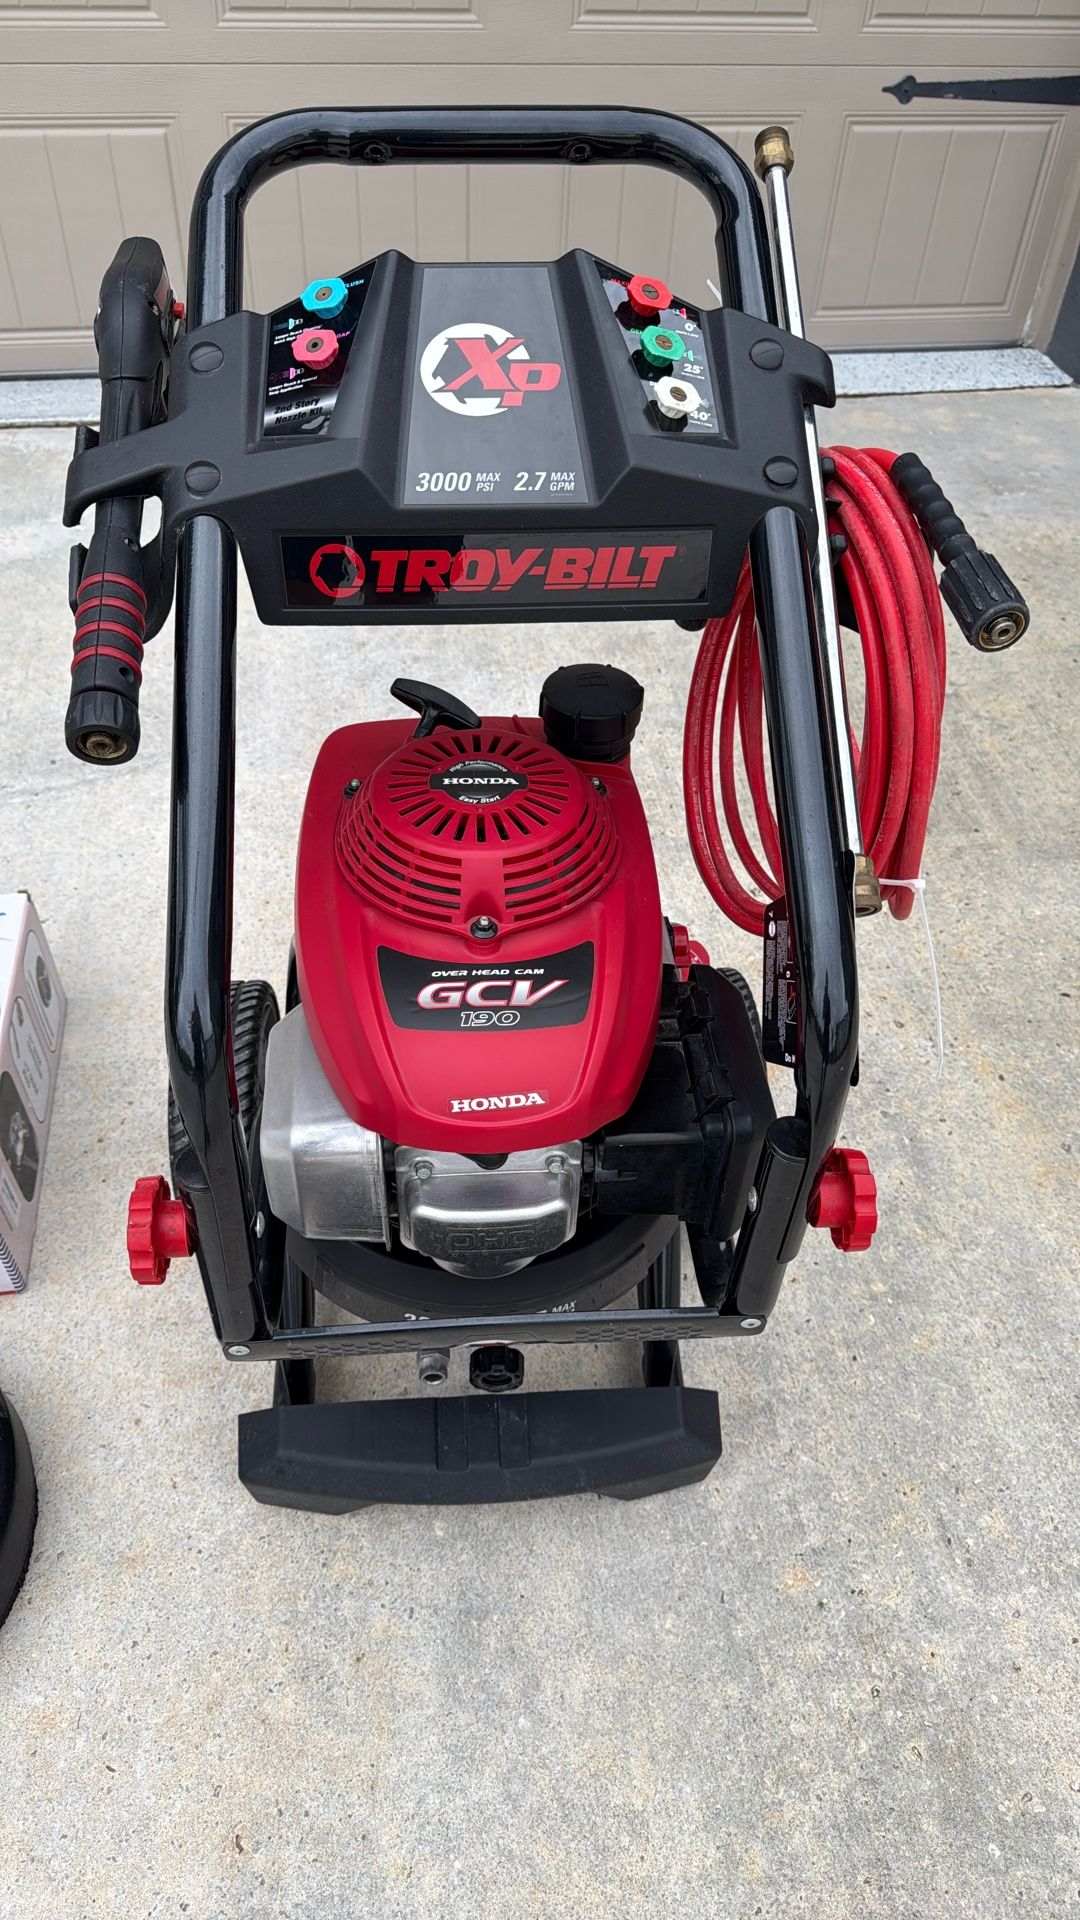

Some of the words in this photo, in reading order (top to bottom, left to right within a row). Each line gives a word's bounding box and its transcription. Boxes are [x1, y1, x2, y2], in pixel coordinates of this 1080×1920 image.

[274, 403, 293, 415] 2nd
[295, 398, 320, 410] Story
[275, 412, 307, 425] Nozzle
[310, 406, 323, 416] Kit
[416, 472, 472, 492] 3000
[475, 472, 502, 482] MAX
[513, 471, 547, 491] 2.7
[550, 472, 575, 481] MAX
[476, 483, 495, 492] PSI
[550, 482, 575, 491] GPM
[370, 545, 677, 593] TROY-BILT
[442, 777, 519, 785] HONDA
[459, 795, 478, 804] Easy
[480, 795, 501, 804] Start
[431, 969, 468, 977] OVER
[416, 979, 570, 1010] GCV
[460, 1010, 520, 1027] 190
[451, 1092, 546, 1113] HONDA
